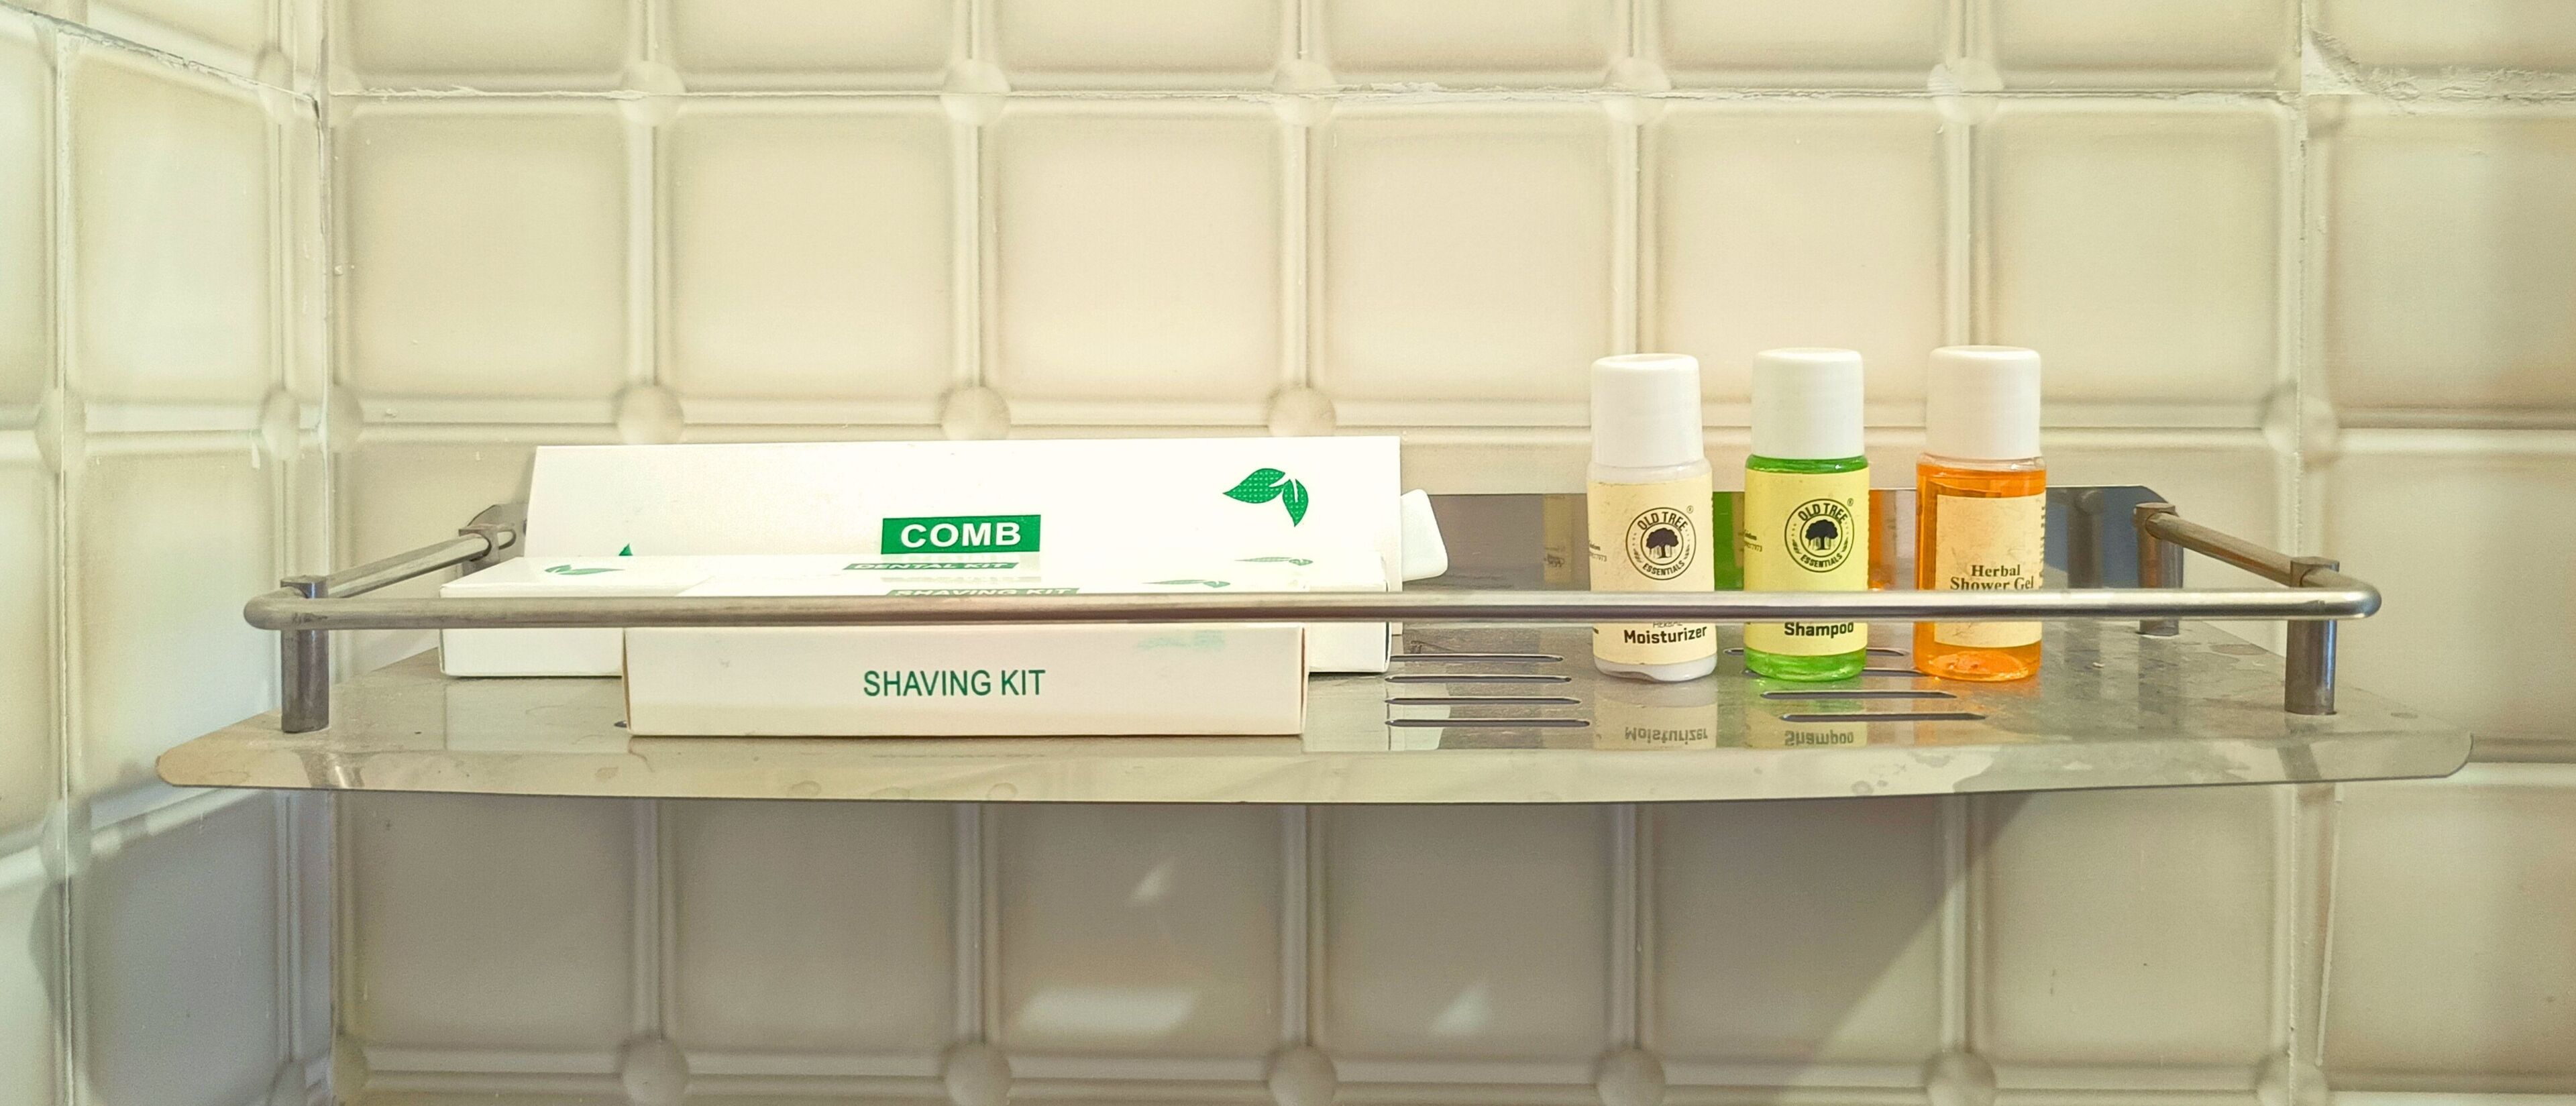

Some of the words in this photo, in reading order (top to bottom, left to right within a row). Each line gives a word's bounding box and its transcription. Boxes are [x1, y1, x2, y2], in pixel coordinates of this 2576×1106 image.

[1637, 512, 1659, 530] OLD
[1662, 512, 1688, 531] TREE
[1798, 504, 1821, 521] OLD
[1823, 503, 1848, 524] TREE
[901, 523, 1021, 548] COMB
[1642, 560, 1685, 575] ESSENTIALS
[1800, 553, 1842, 567] ESSENTIALS
[1972, 565, 2021, 577] Herbal
[1950, 577, 2010, 590] Shower
[2014, 576, 2033, 590] Gel
[1624, 626, 1707, 644] Moisturizer
[1784, 622, 1854, 638] Shampoo
[863, 671, 991, 696] SHAVING
[1002, 669, 1046, 695] KIT
